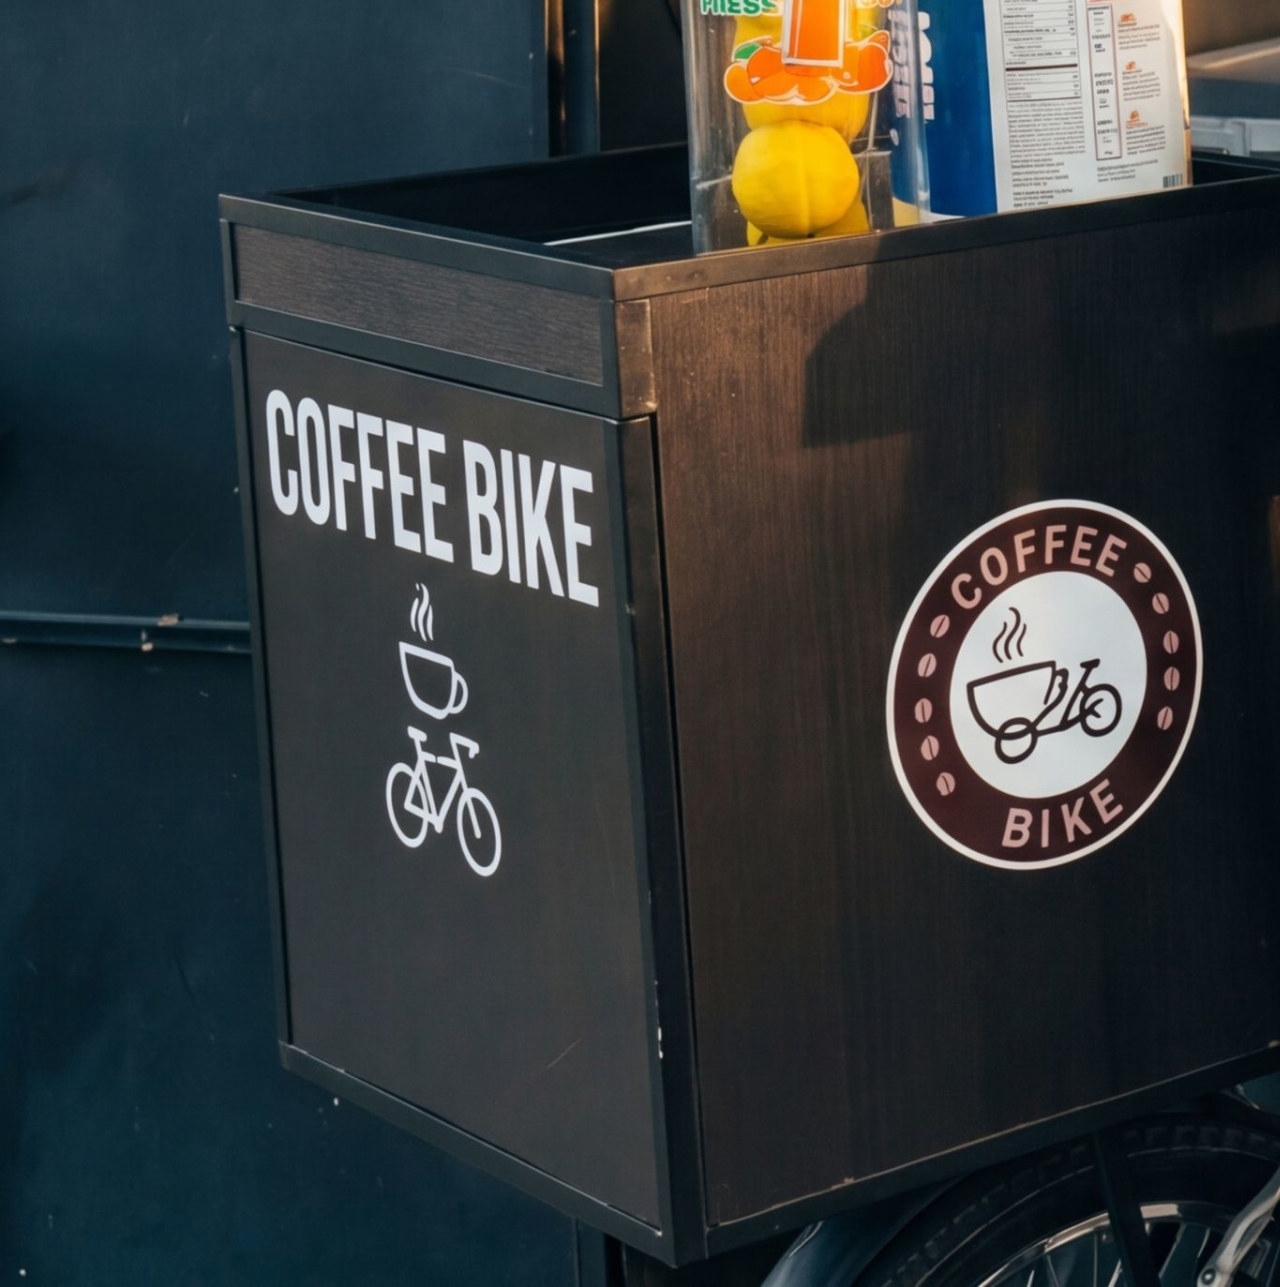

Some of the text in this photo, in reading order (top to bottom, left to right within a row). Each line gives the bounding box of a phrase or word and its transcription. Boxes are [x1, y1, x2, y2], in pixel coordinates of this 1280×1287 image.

[265, 389, 600, 607] COFFEE BIKE
[950, 523, 1128, 611] COFFEE
[1001, 777, 1124, 851] BIKE
